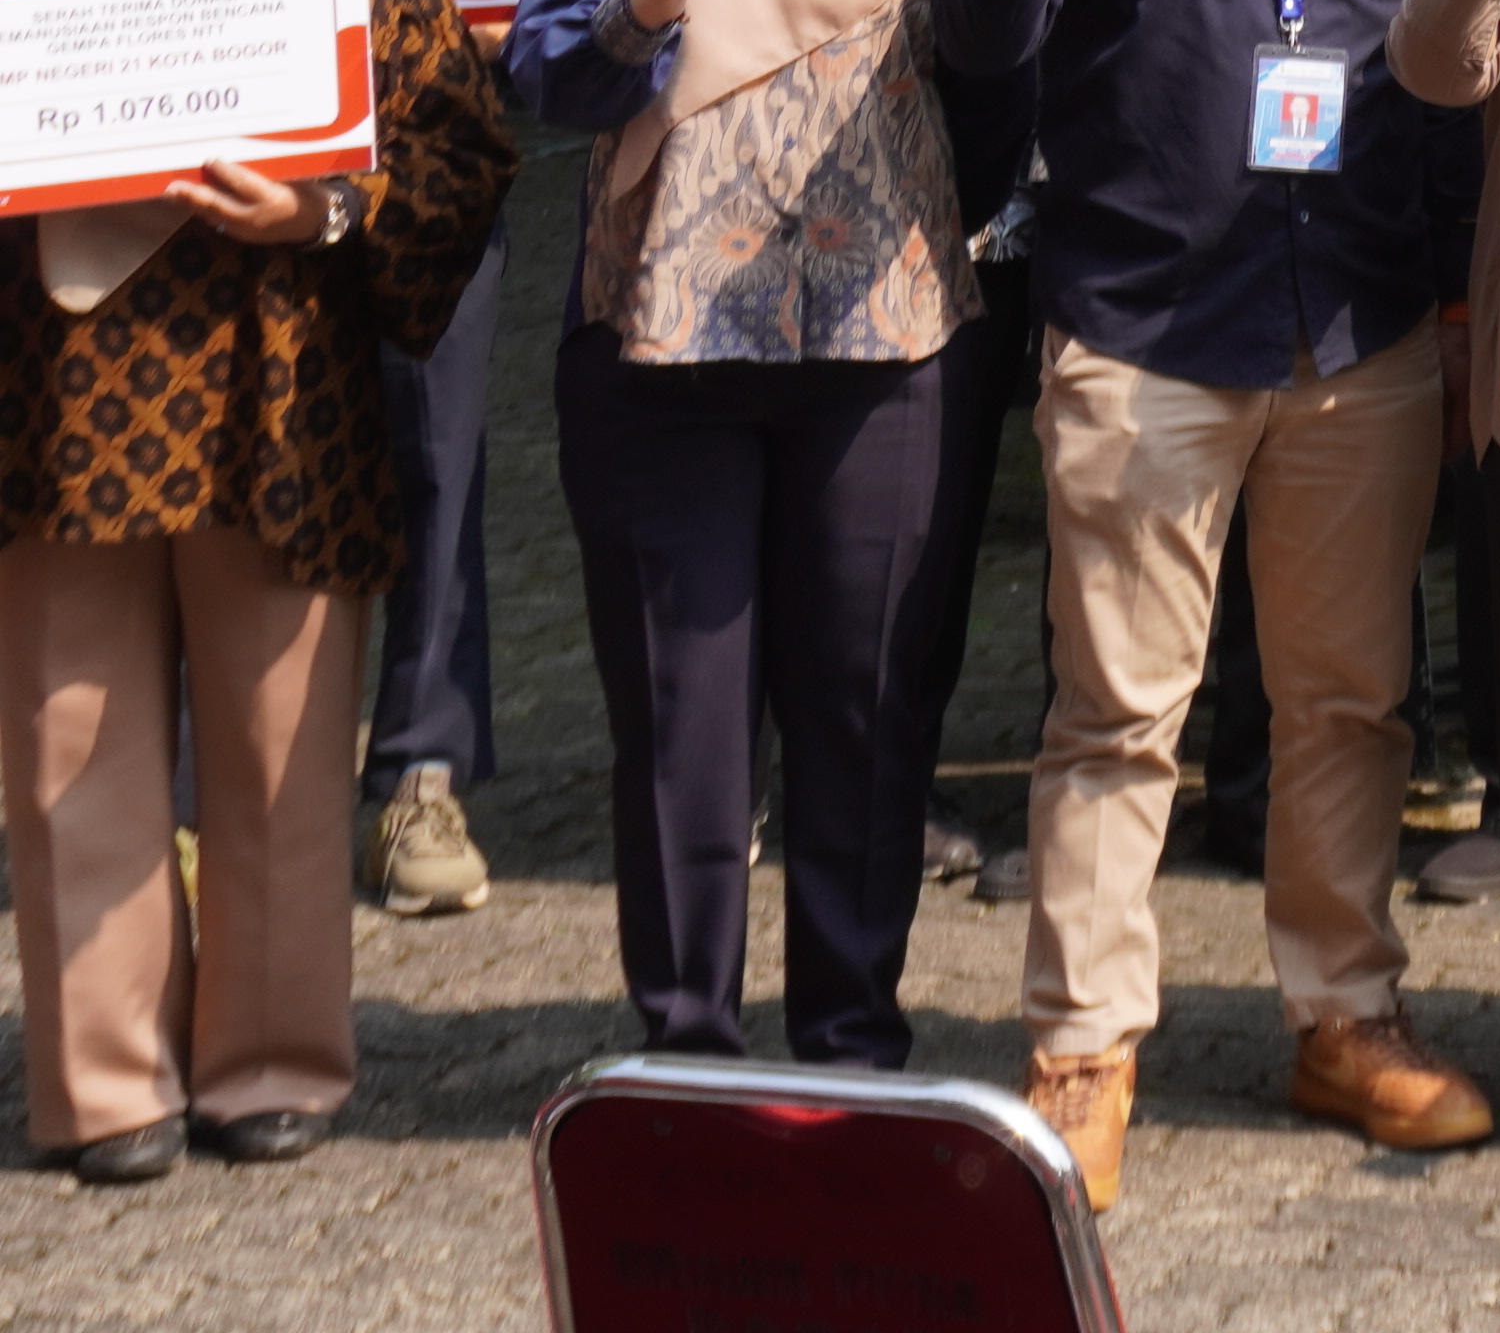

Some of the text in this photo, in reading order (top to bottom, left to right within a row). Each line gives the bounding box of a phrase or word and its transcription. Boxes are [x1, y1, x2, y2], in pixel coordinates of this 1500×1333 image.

[0, 40, 287, 86] MP NEGERI 21 KOTA BOGOR
[37, 87, 240, 133] Rp 1.076.000
